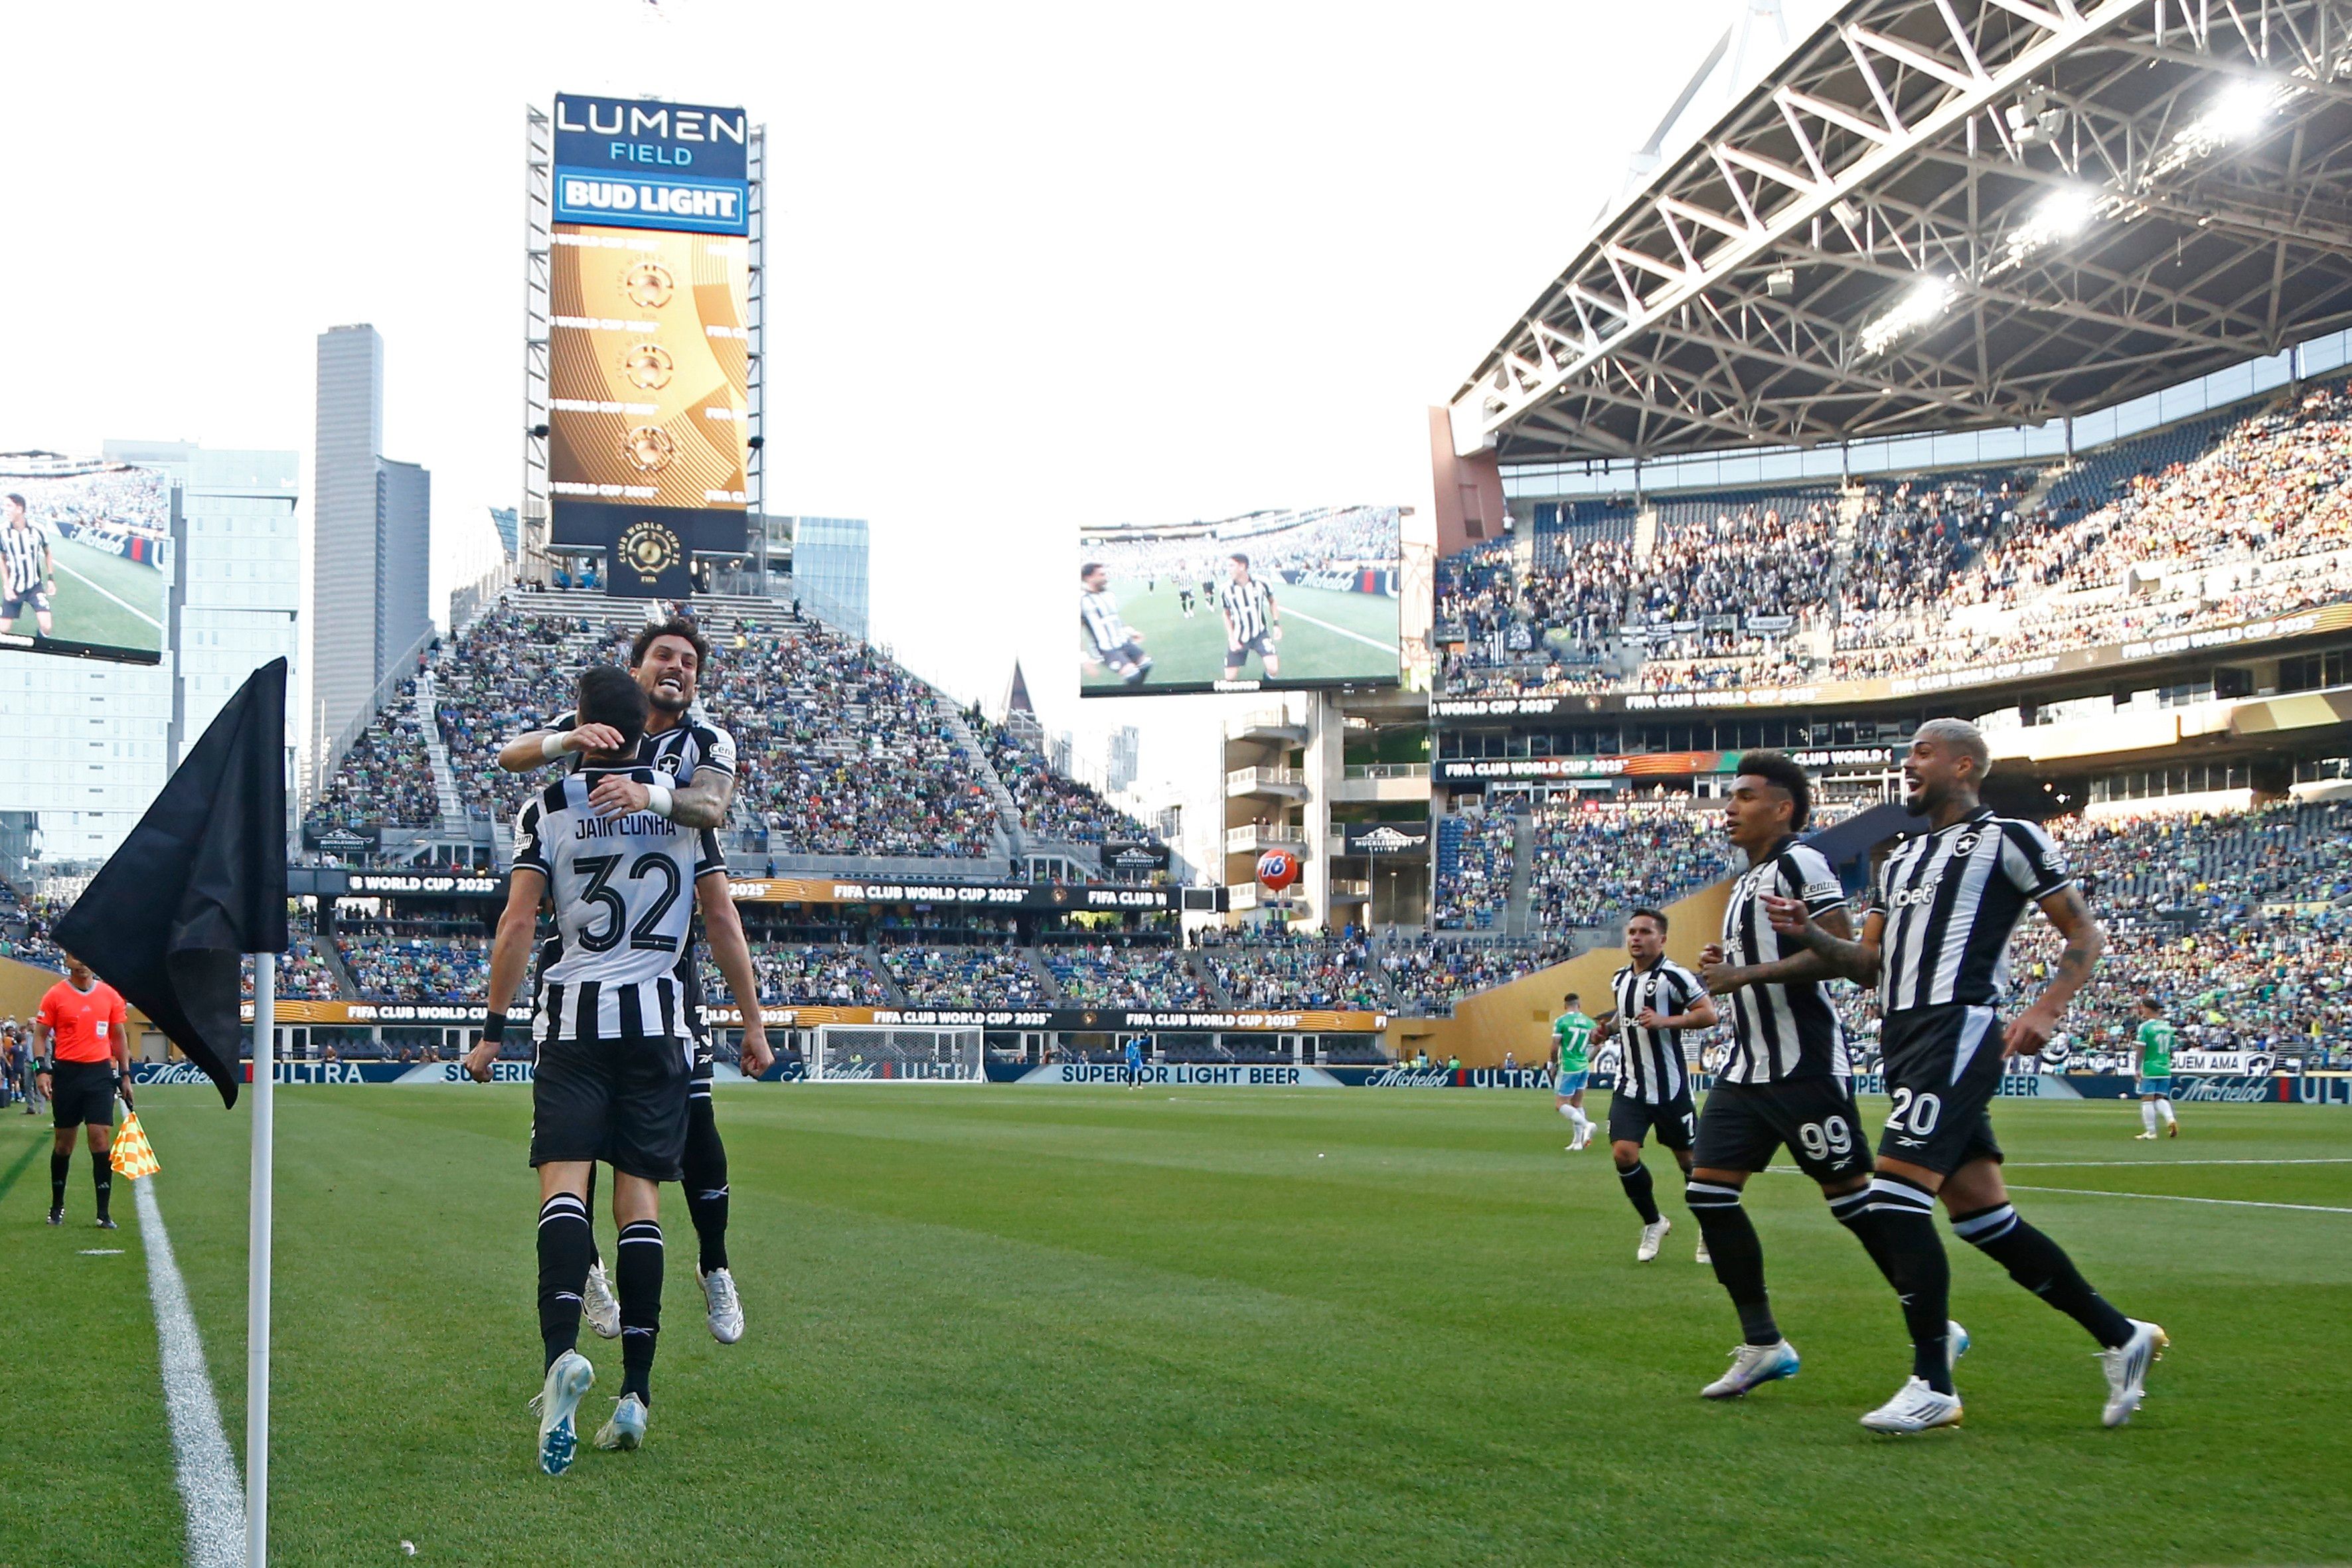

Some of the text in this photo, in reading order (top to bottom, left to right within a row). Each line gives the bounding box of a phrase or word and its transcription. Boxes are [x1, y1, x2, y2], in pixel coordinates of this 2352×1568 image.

[558, 101, 745, 145] LUMEN
[610, 141, 693, 165] FIELD
[566, 180, 737, 217] BUD LIGHT
[626, 522, 664, 535] WORLD
[665, 530, 681, 550] CUP
[1295, 569, 1358, 591] Michelob
[2189, 627, 2243, 649] WORLD
[2243, 621, 2274, 639] CUP
[1439, 701, 1488, 716] WORLD
[1489, 700, 1518, 715] CUP
[1625, 694, 1656, 710] FIFA
[1657, 693, 1694, 708] CLUB
[1695, 690, 1747, 706] WORLD
[1748, 688, 1779, 704] CUP
[1445, 763, 1474, 777] FIFA
[1474, 761, 1509, 776] CLUB
[1510, 760, 1559, 775] WORLD
[1561, 759, 1589, 773] CUP
[1792, 751, 1829, 766] CLUB
[1830, 749, 1883, 764] WORLD
[576, 817, 676, 840] JAIR CUNHA
[1261, 857, 1287, 877] 76
[350, 876, 363, 890] B
[365, 876, 422, 891] WORLD
[423, 877, 454, 892] CUP
[834, 885, 864, 900] FIFA
[867, 886, 905, 900] CLUB
[906, 886, 957, 901] WORLD
[958, 888, 986, 902] CUP
[573, 852, 681, 953] 32
[1088, 891, 1118, 905] FIFA
[1119, 892, 1154, 905] CLUB
[348, 1006, 532, 1020] FIFA CLUB WORLD CU 025
[732, 1009, 744, 1022] C
[874, 1011, 902, 1024] FIFA
[903, 1011, 937, 1024] CLUB
[938, 1012, 985, 1025] WORLD
[986, 1012, 1013, 1025] CUP
[1126, 1013, 1154, 1026] FIFA
[1155, 1014, 1188, 1027] CLUB
[1188, 1014, 1235, 1028] WORLD
[1237, 1014, 1263, 1027] CUP
[1567, 1026, 1591, 1053] 77
[135, 1061, 212, 1085] Miche
[445, 1063, 534, 1081] SUERI
[2211, 1056, 2239, 1069] AMA
[1062, 1065, 1300, 1085] SUPERIOR LIGHT BEER
[1365, 1067, 1554, 1088] Michelob ULTRA
[2169, 1074, 2268, 1101] Michelob
[1884, 1087, 1941, 1136] 20
[1800, 1115, 1852, 1160] 99
